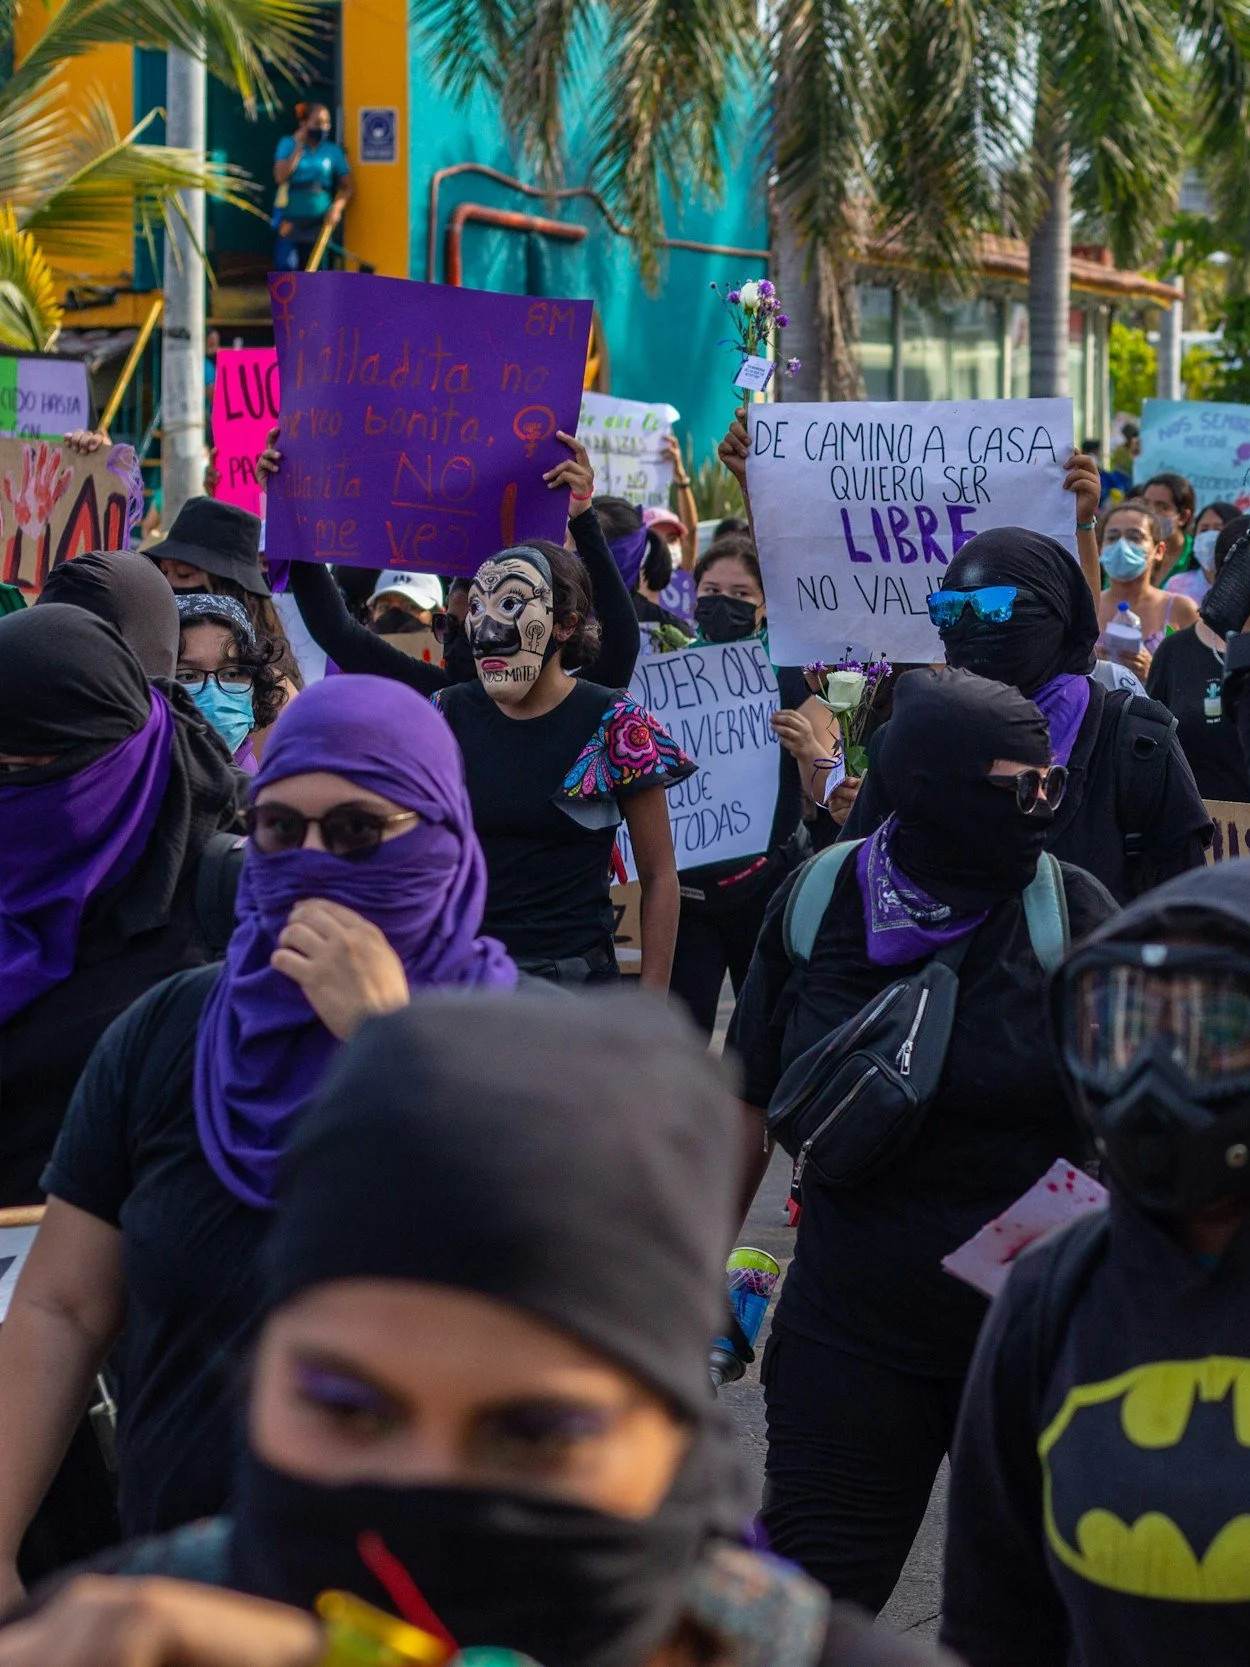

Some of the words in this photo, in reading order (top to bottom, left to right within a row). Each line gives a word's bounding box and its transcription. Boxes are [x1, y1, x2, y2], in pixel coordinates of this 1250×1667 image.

[500, 357, 549, 394] no
[754, 421, 789, 459] DE
[804, 421, 913, 464] CAMINO
[922, 425, 946, 464] A
[968, 425, 1057, 464] CASA
[393, 452, 477, 502] NO
[830, 465, 925, 501] QUIERO
[942, 465, 992, 504] SER
[314, 518, 357, 550] me
[840, 504, 978, 566] LIBRE
[796, 575, 839, 611] NO
[721, 645, 778, 700] QUE
[668, 771, 713, 809] QUE
[669, 800, 751, 852] TODAS
